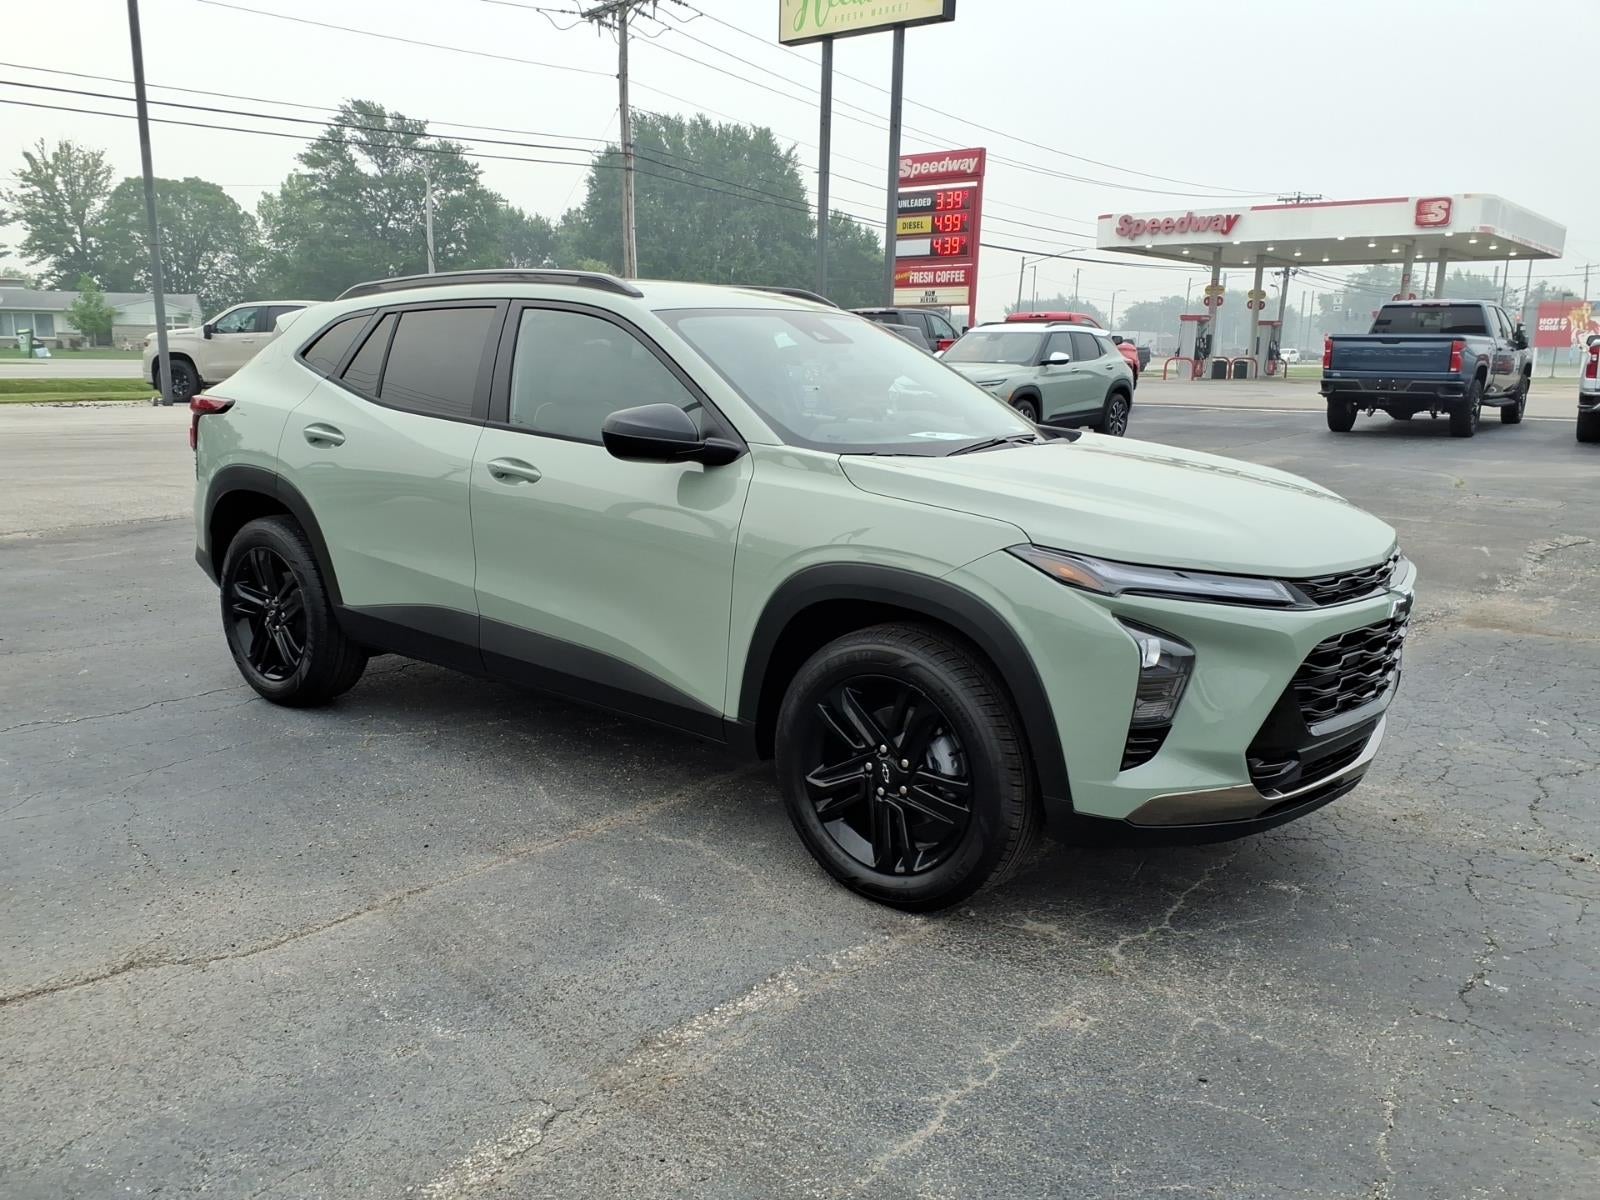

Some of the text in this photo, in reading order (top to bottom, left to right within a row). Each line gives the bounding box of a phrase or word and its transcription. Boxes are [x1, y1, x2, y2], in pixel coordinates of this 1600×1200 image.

[899, 157, 979, 178] Speedway
[898, 198, 932, 209] UNLEADED
[902, 221, 924, 230] DIESEL
[1116, 211, 1241, 240] Speedway
[909, 271, 934, 284] FRESH
[935, 270, 965, 283] COFFEE
